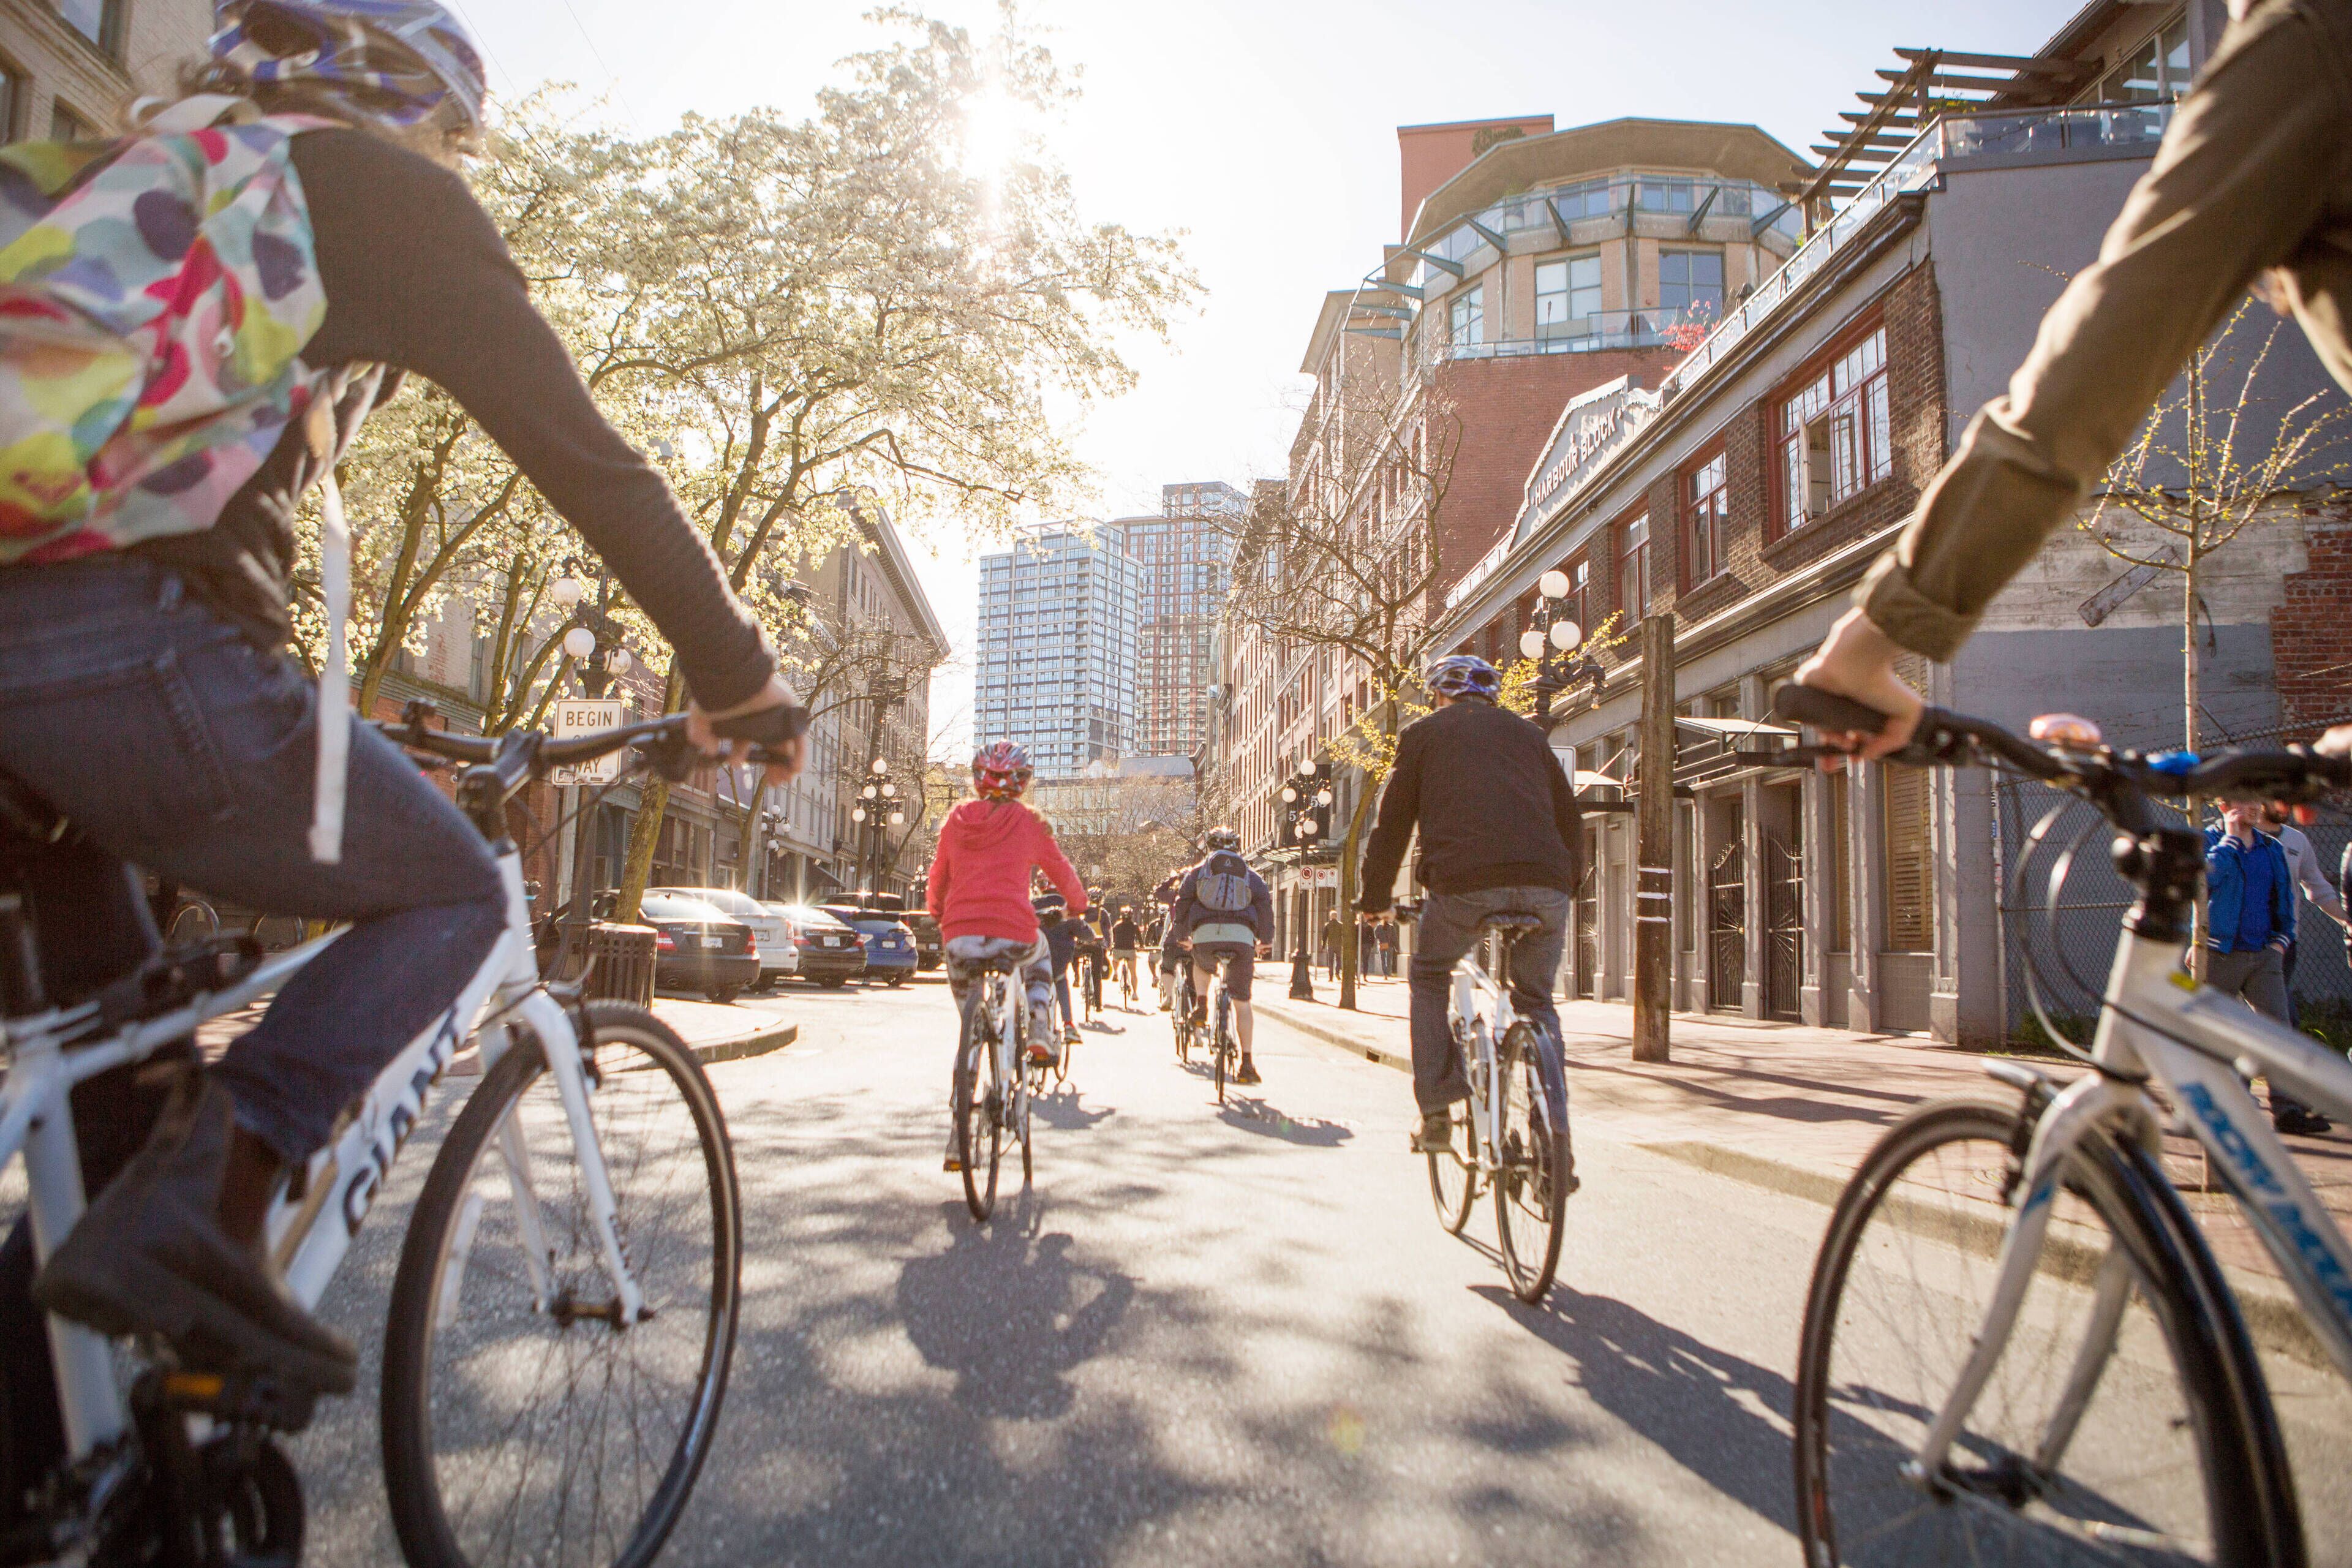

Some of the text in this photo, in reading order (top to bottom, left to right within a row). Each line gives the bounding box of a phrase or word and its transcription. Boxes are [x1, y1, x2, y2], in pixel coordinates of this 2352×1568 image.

[1535, 407, 1616, 507] HARBOUR BLOCK
[566, 711, 612, 726] BEGIN
[343, 1005, 466, 1237] GIANT
